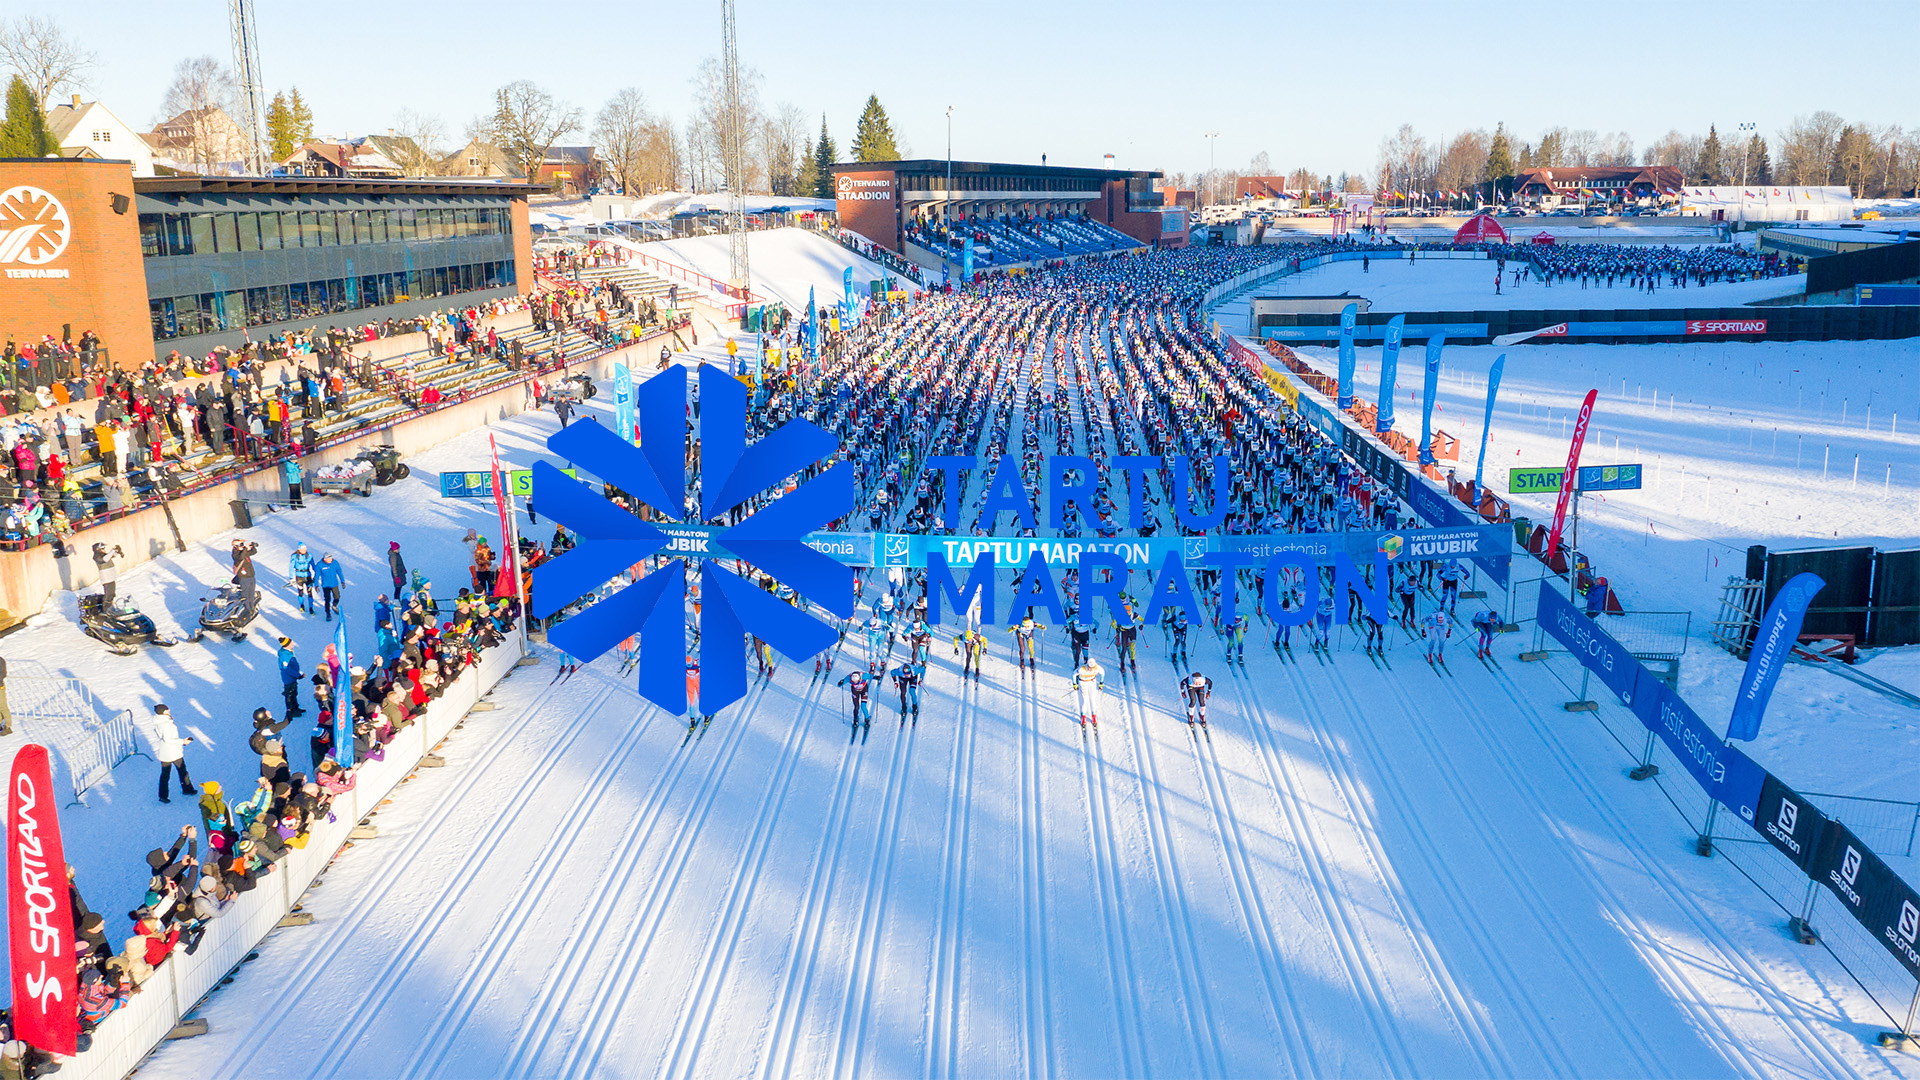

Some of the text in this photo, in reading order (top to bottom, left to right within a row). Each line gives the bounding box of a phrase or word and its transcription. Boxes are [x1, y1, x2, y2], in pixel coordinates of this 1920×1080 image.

[837, 191, 890, 200] STAADION
[1705, 321, 1765, 332] SPORTLAND
[1516, 472, 1564, 488] START
[667, 529, 710, 538] MARATONI
[1437, 532, 1479, 540] MARATONI
[660, 538, 710, 552] UBIK
[942, 541, 1022, 564] TARTU
[1238, 542, 1327, 557] visit estonia
[1410, 539, 1479, 556] KUUBIK
[1557, 608, 1614, 672] visit estonia
[1661, 700, 1726, 784] visit estonia
[17, 772, 61, 957] SPORTLAND
